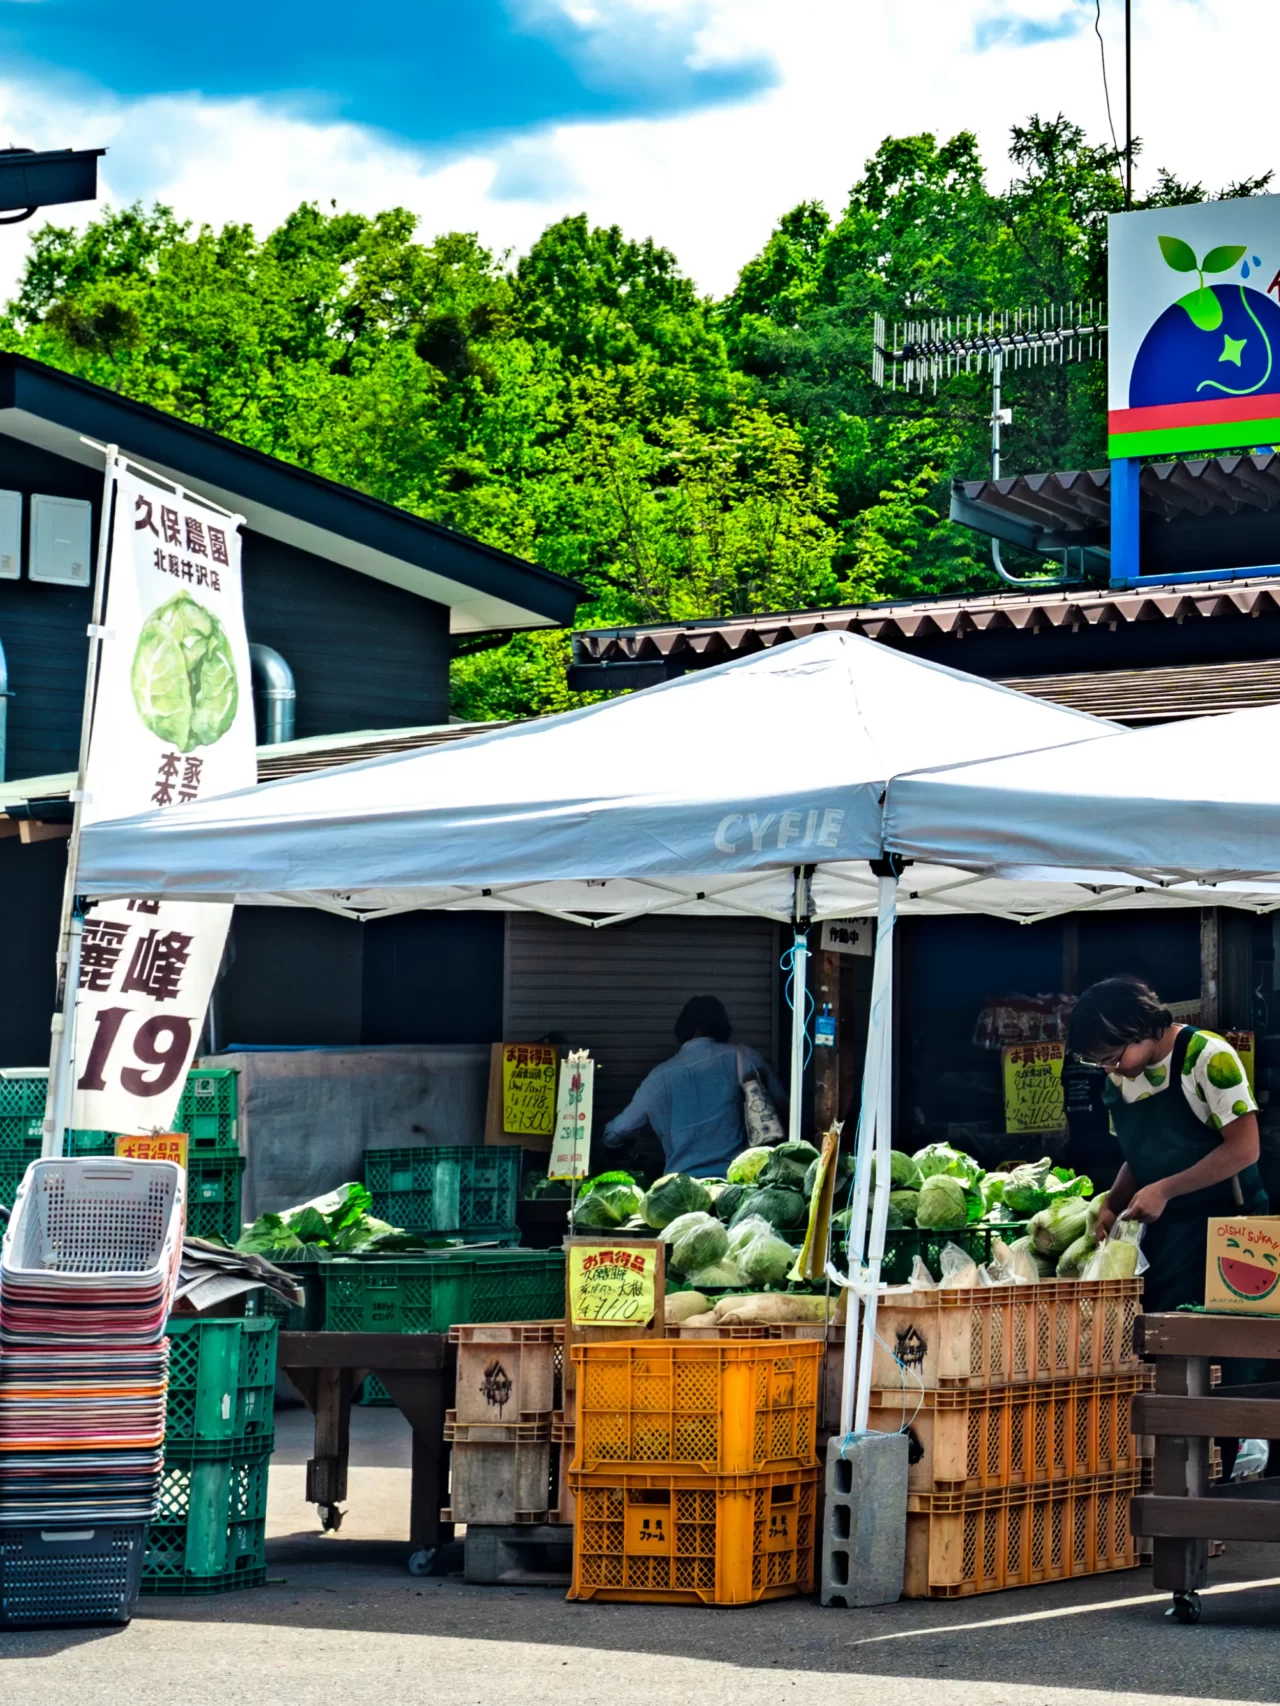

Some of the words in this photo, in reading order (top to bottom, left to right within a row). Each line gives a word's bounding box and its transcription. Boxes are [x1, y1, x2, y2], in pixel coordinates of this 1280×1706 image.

[135, 494, 229, 567] 久保農園
[153, 547, 221, 592] 北軽井沢店
[77, 1005, 200, 1098] 19
[507, 1047, 554, 1068] お買得品
[1011, 1044, 1062, 1068] お買得品
[1217, 1225, 1246, 1237] OISHI
[583, 1251, 646, 1273] お買得品
[640, 1530, 666, 1542] ファーム
